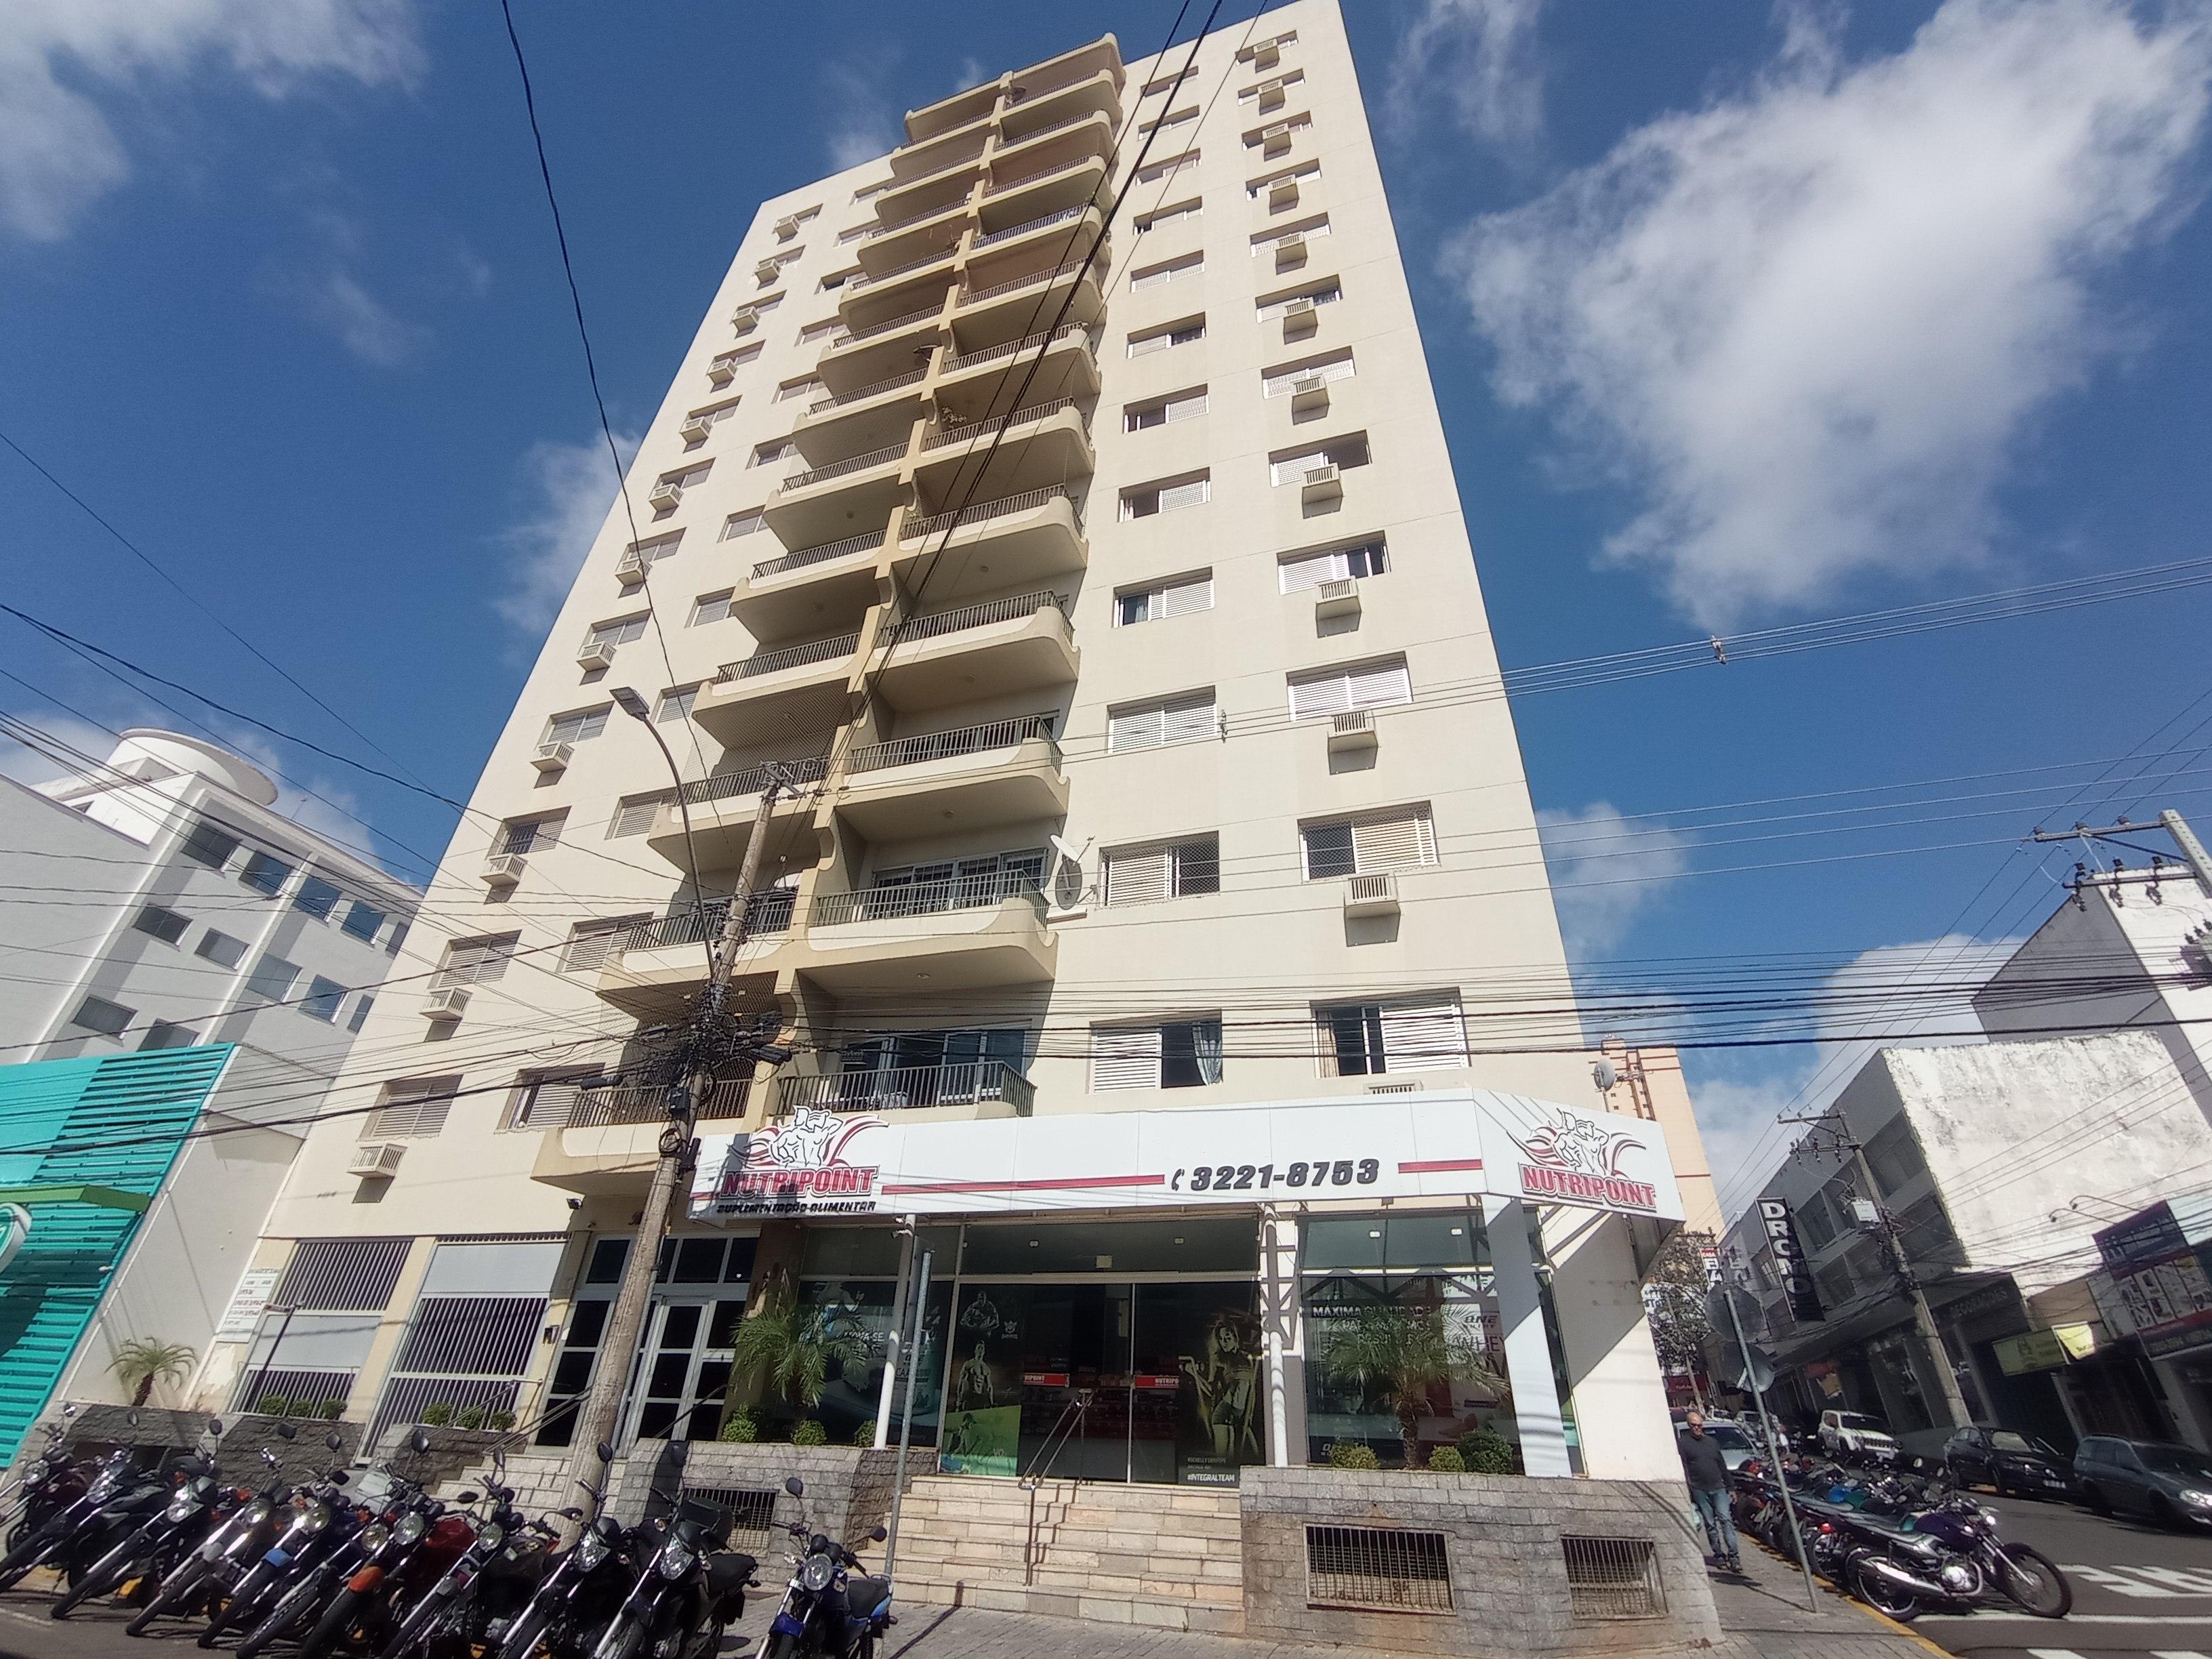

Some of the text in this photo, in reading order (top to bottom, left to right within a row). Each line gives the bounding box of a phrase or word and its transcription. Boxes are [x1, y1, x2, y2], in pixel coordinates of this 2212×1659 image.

[720, 1168, 876, 1197] NUTRIPOINT
[1190, 1158, 1380, 1191] 3221-8753
[1522, 1164, 1656, 1209] NUTRIPOINT
[810, 1201, 877, 1212] ALIMENTAR
[1313, 1305, 1362, 1317] MÁXIMA
